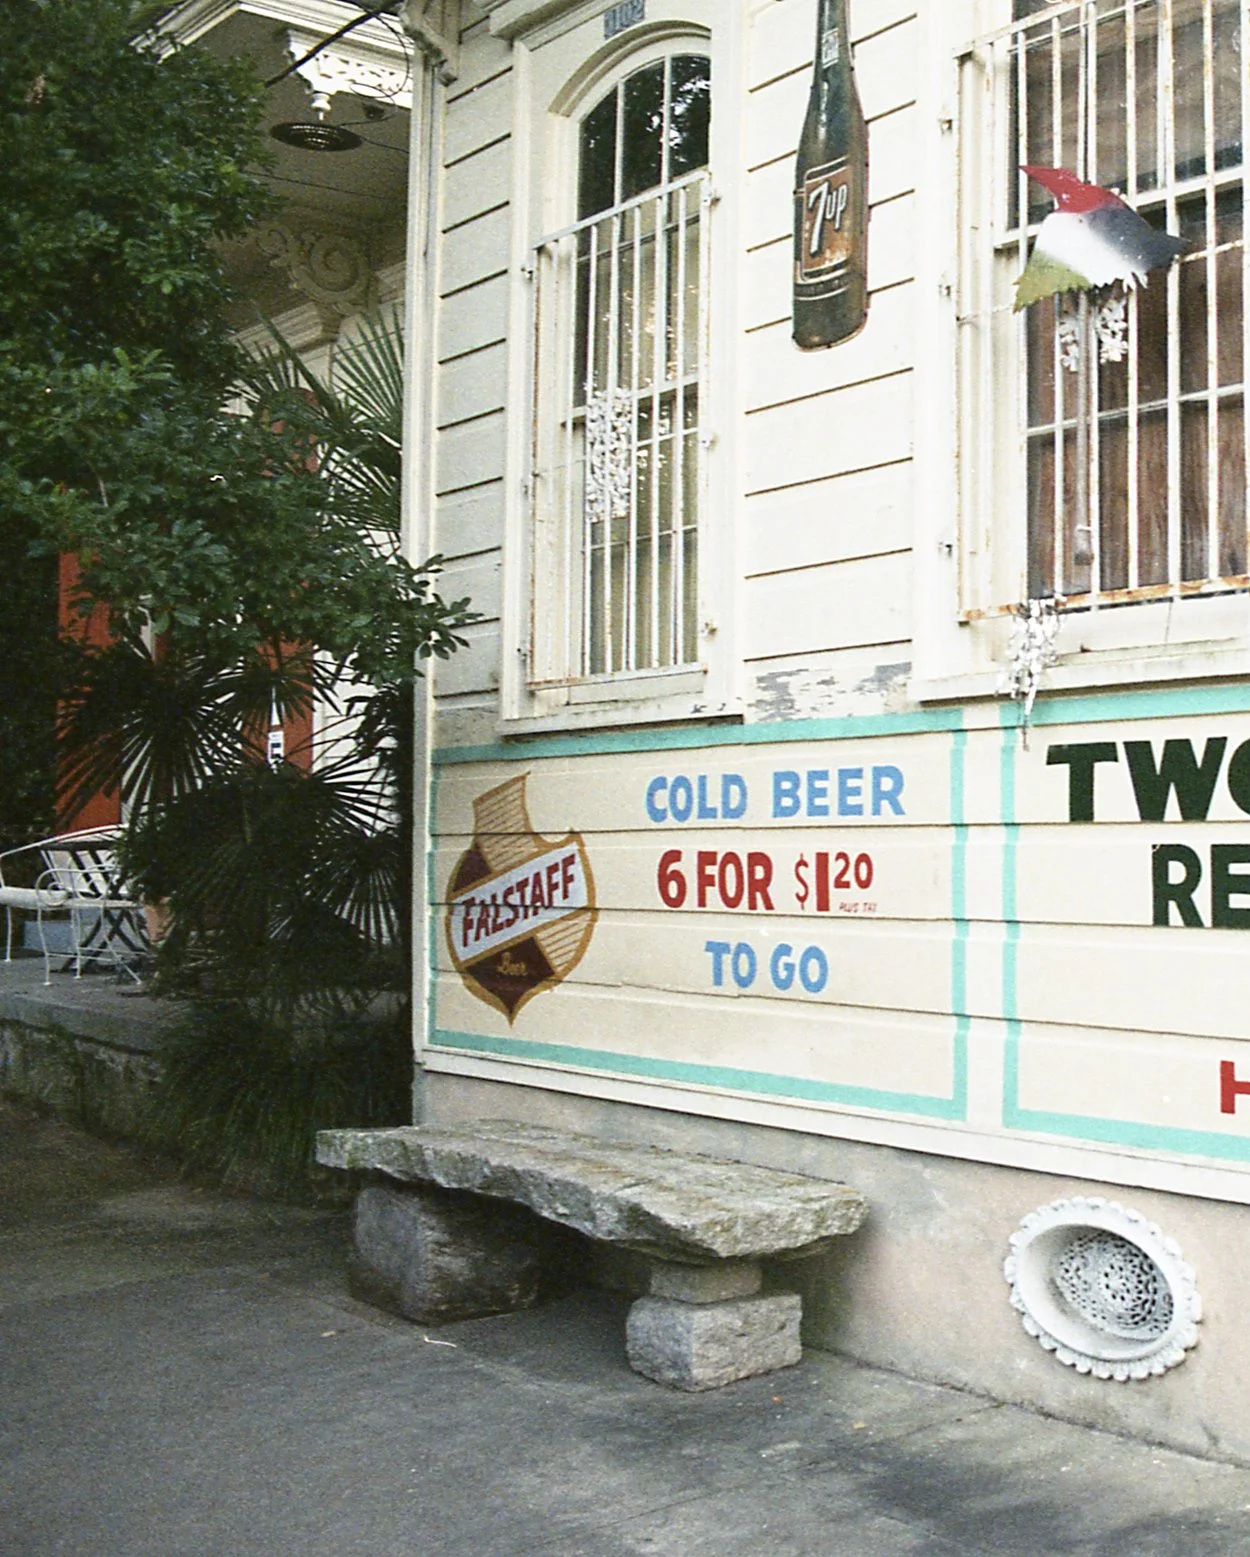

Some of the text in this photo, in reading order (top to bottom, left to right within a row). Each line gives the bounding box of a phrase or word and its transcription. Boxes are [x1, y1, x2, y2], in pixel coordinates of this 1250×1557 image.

[645, 765, 905, 823] COLD BEER
[461, 853, 576, 948] FALSTAFF
[657, 849, 687, 908] 6
[697, 850, 775, 911] FOR
[705, 941, 829, 994] TO GO
